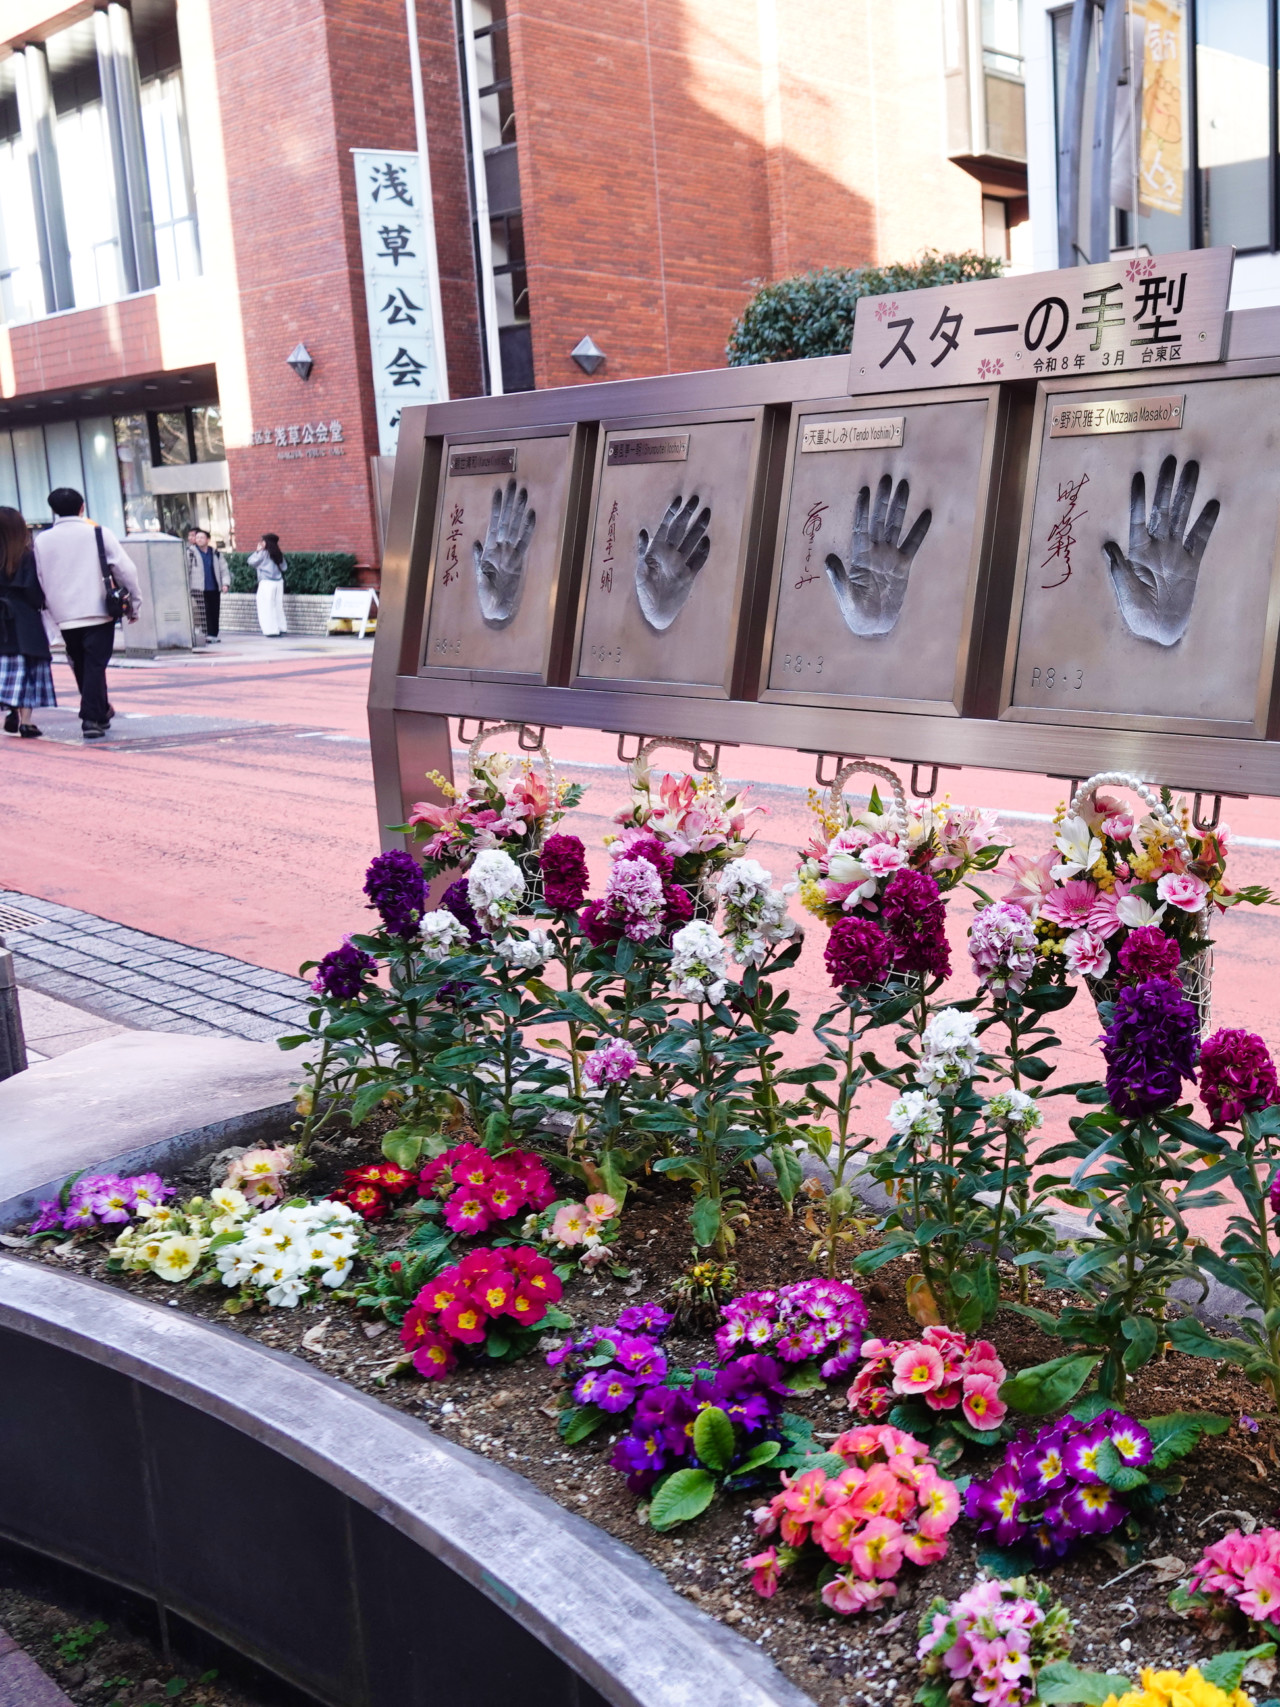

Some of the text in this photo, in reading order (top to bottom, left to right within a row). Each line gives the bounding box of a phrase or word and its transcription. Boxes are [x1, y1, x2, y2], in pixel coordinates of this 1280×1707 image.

[369, 162, 428, 428] 浅草公会
[878, 272, 1188, 369] スターの手型
[1032, 344, 1183, 374] 令和8年 3月 台東区
